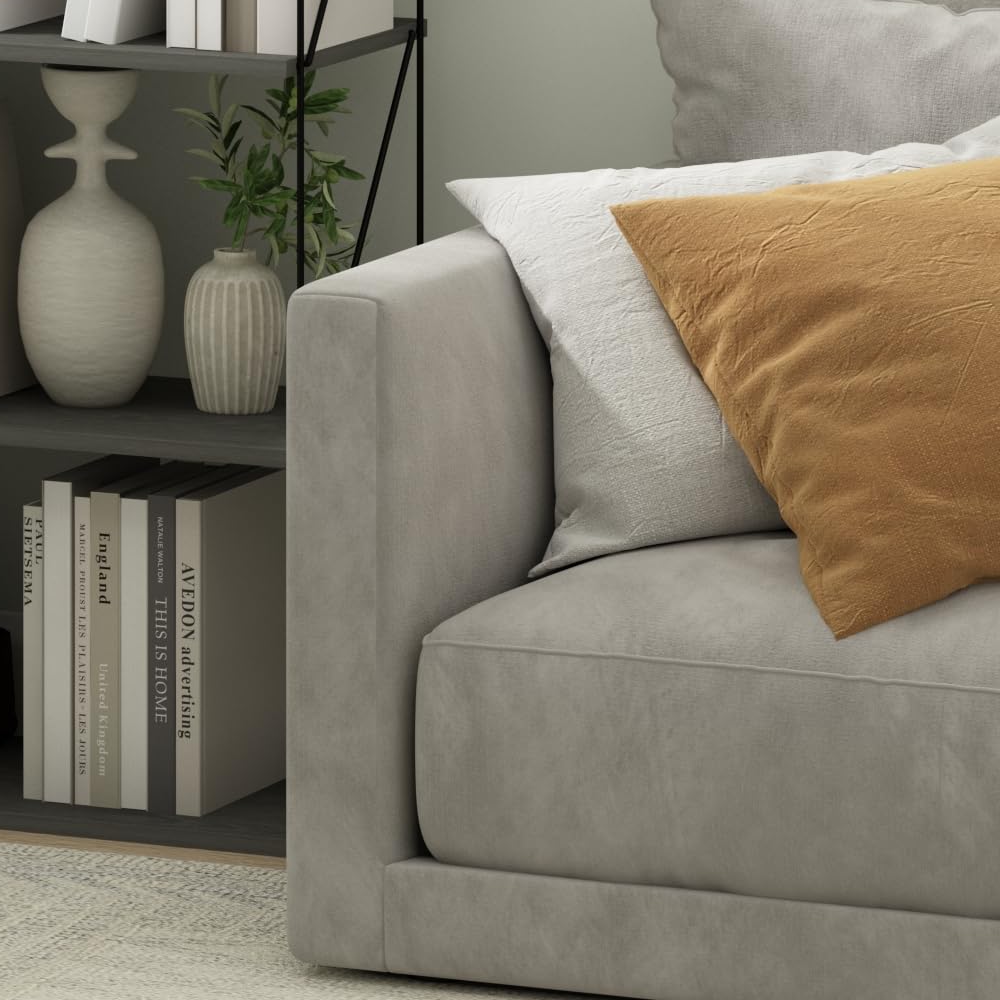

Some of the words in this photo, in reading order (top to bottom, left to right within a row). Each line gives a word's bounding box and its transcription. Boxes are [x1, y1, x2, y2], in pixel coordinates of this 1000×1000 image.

[35, 519, 43, 565] PAUL
[156, 516, 164, 549] NATALIE
[24, 516, 33, 607] SIETSEMA
[96, 532, 111, 606] England
[156, 550, 164, 584] WALTON
[154, 597, 168, 640] THIS
[181, 562, 195, 641] AVEDON
[78, 615, 87, 639] LES
[78, 644, 87, 704] PLAISIRS
[154, 645, 168, 662] IS
[98, 663, 108, 709] United
[154, 667, 168, 724] HOME
[177, 646, 195, 740] advertising
[78, 713, 87, 735] LES
[96, 714, 108, 777] Kingdom
[78, 739, 87, 776] JOURS
